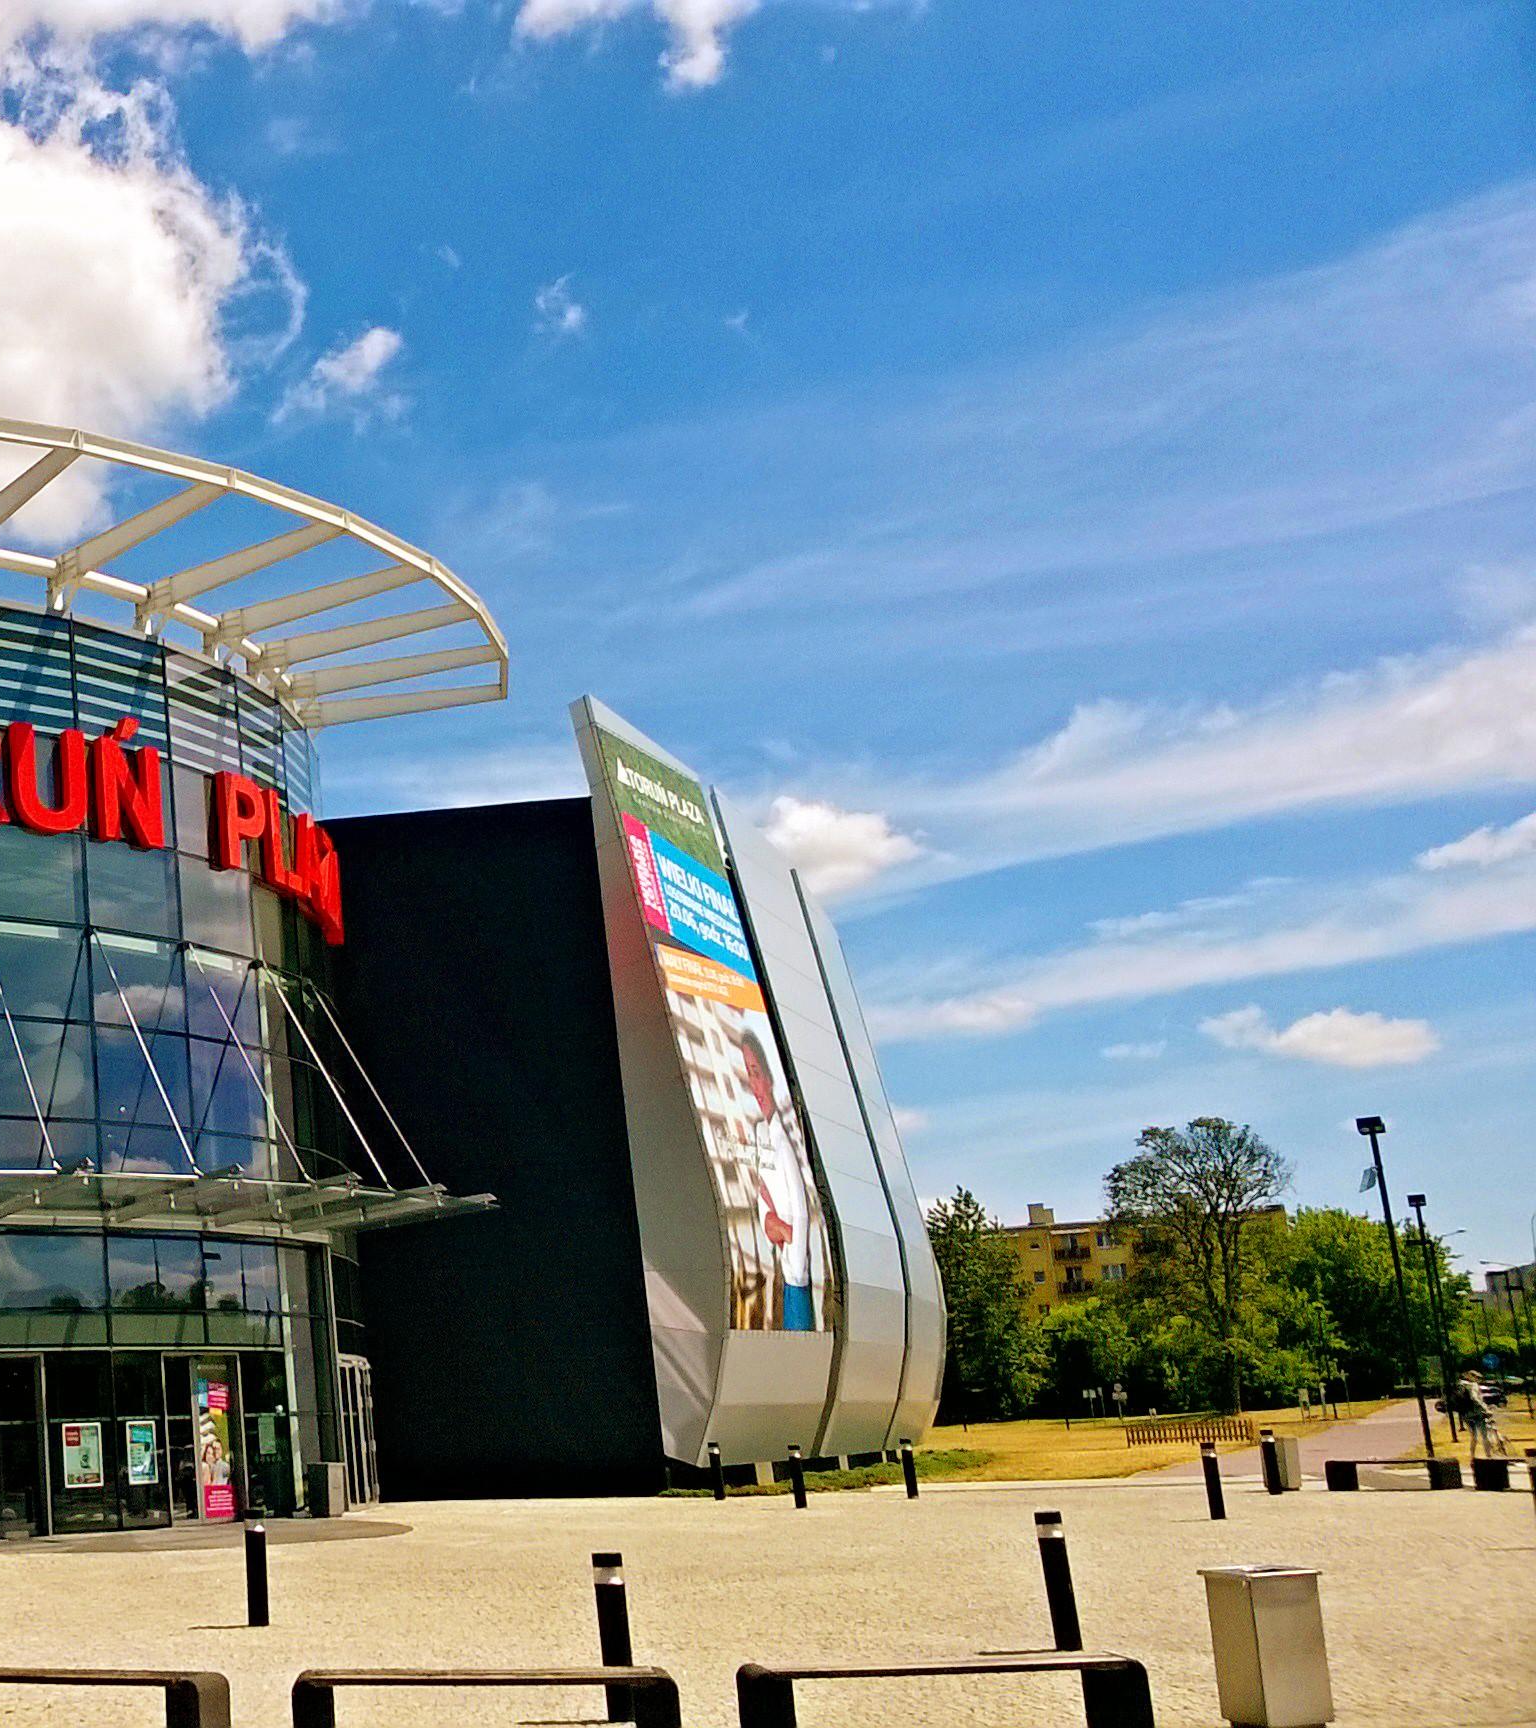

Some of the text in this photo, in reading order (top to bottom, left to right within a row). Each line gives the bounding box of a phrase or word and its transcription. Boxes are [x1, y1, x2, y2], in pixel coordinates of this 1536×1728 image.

[625, 767, 669, 808] TORUŃ
[667, 790, 706, 826] PLAZA
[656, 852, 704, 901] WIELKI
